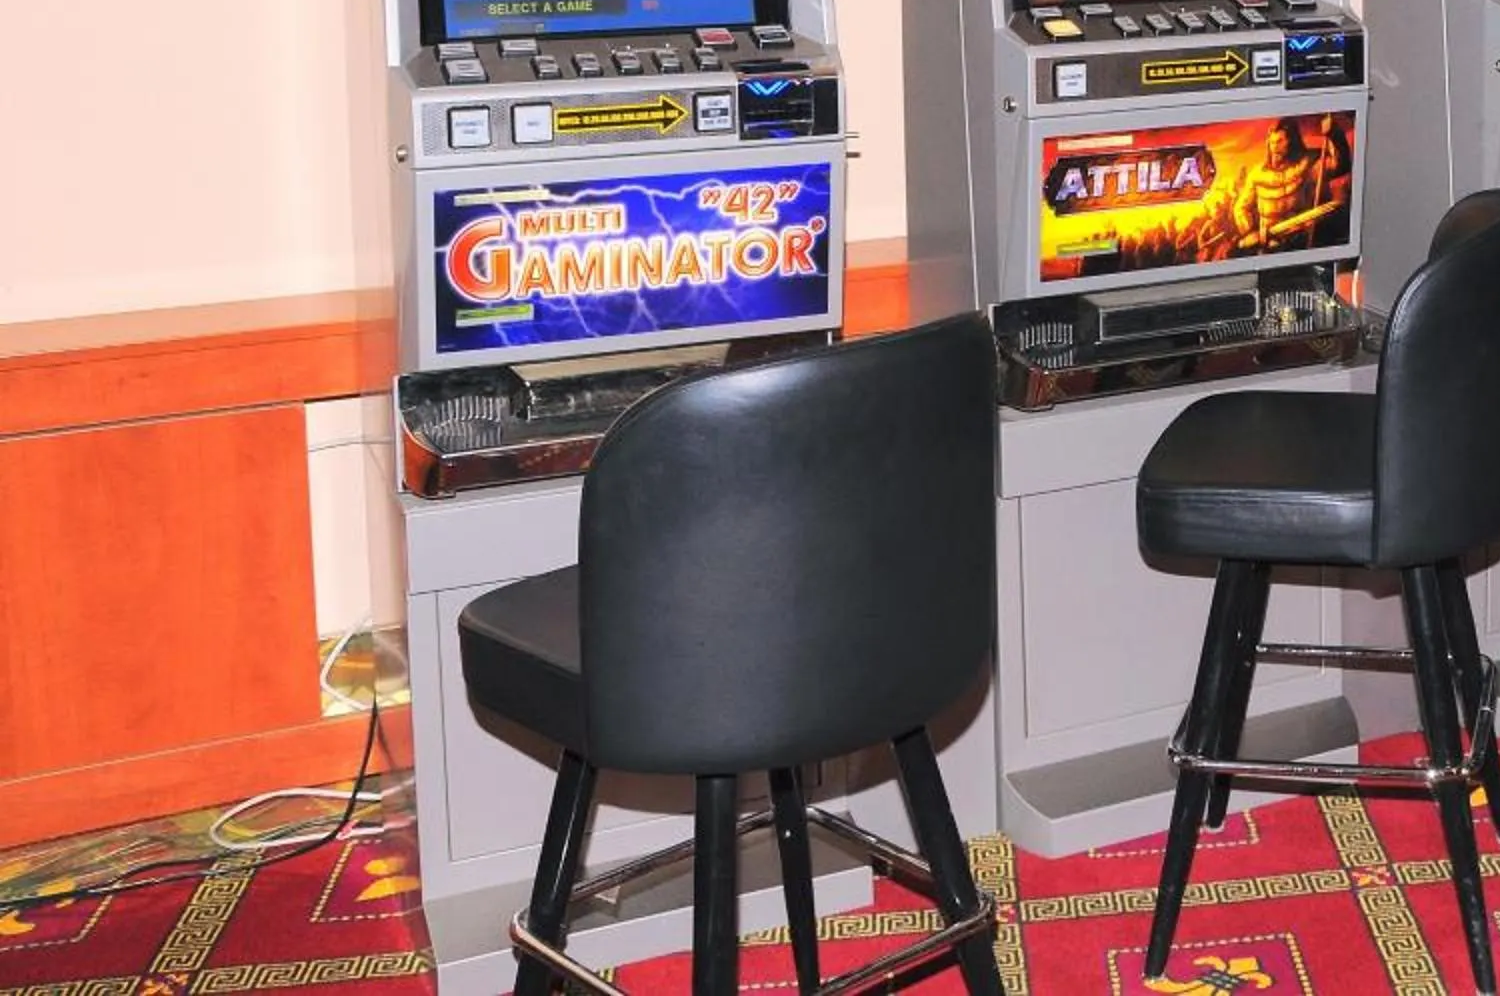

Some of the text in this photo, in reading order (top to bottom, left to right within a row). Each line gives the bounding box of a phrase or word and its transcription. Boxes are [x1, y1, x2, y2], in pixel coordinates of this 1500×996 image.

[488, 0, 593, 15] SELECT A GAME
[1055, 157, 1203, 201] ATTILA
[519, 209, 623, 237] MULTI
[447, 215, 816, 302] GAMINATOR
